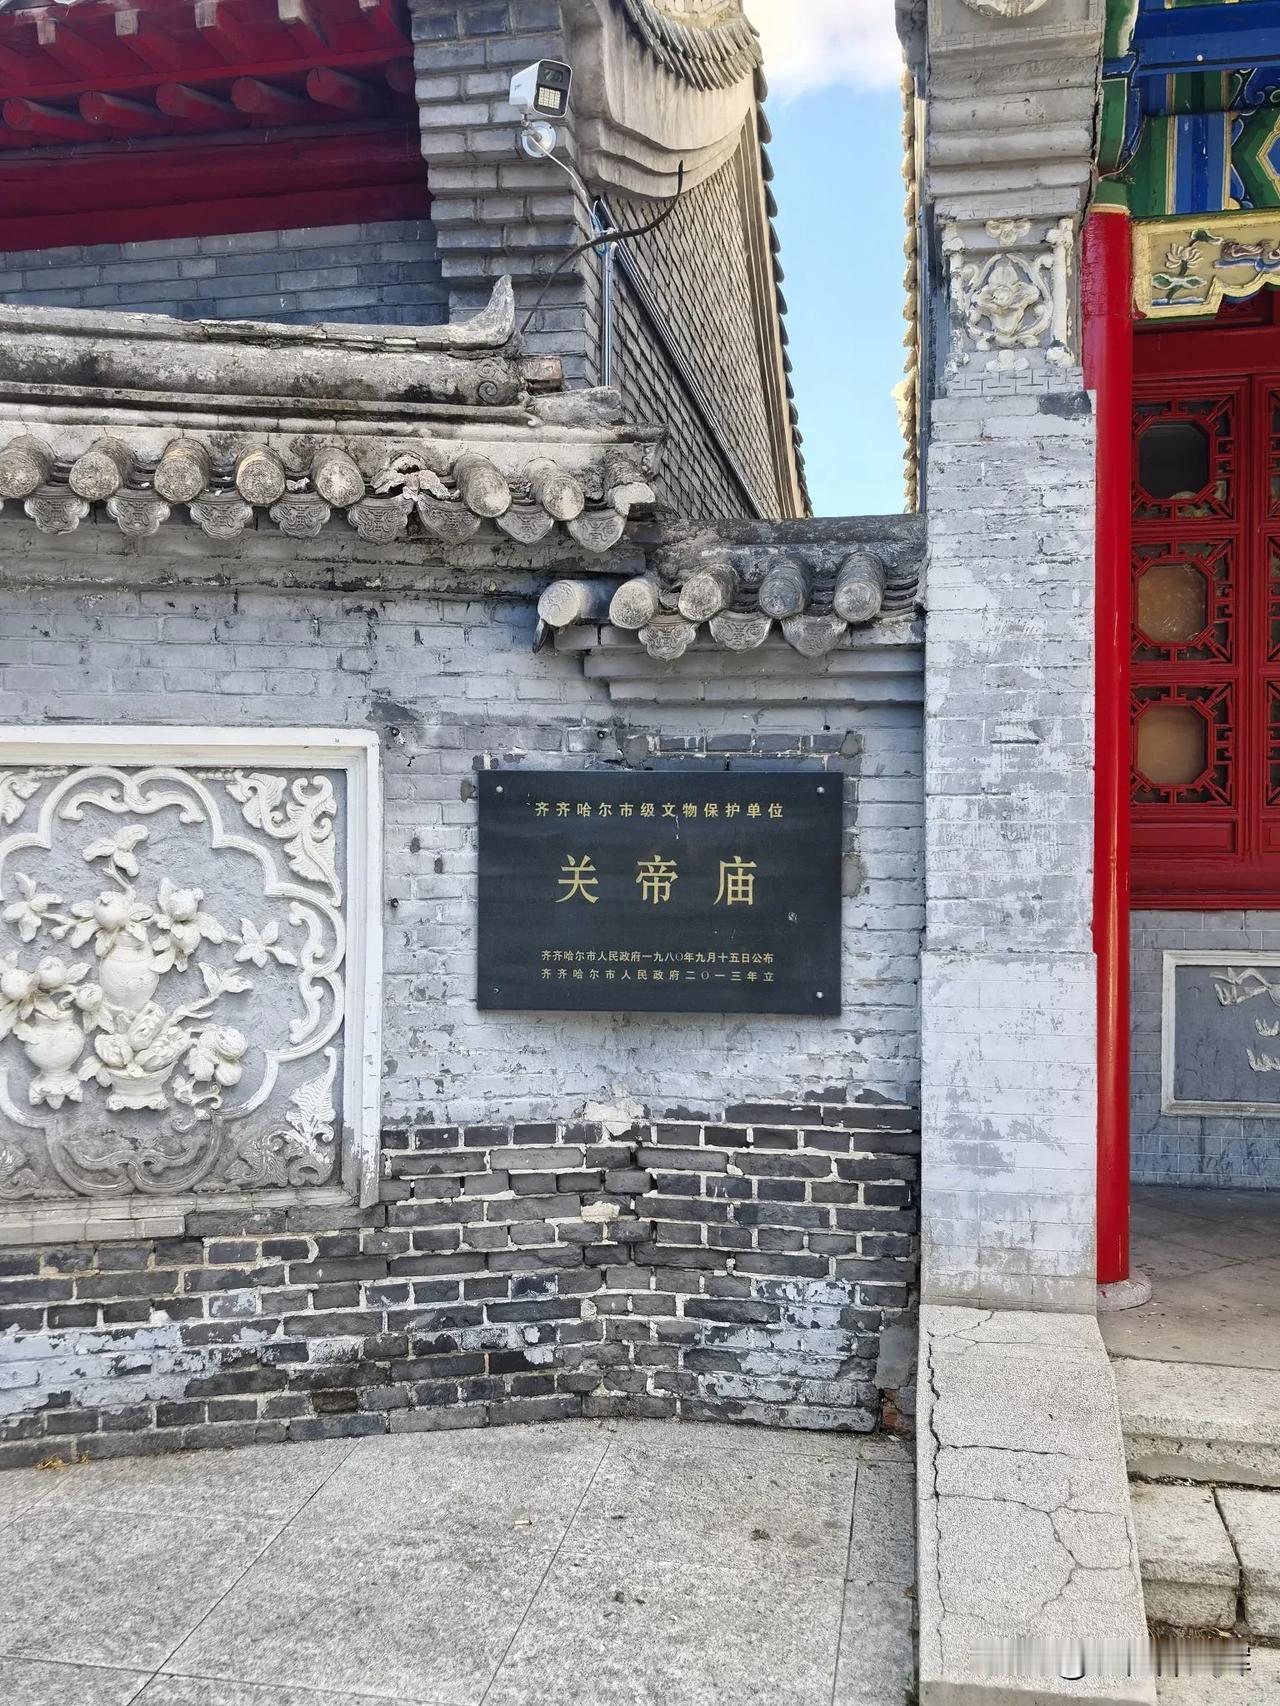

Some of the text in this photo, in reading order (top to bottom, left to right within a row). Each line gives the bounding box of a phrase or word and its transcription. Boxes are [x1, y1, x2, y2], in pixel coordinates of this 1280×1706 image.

[535, 801, 784, 819] 齐齐哈尔市级文物保护单位
[555, 854, 758, 906] 关帝庙
